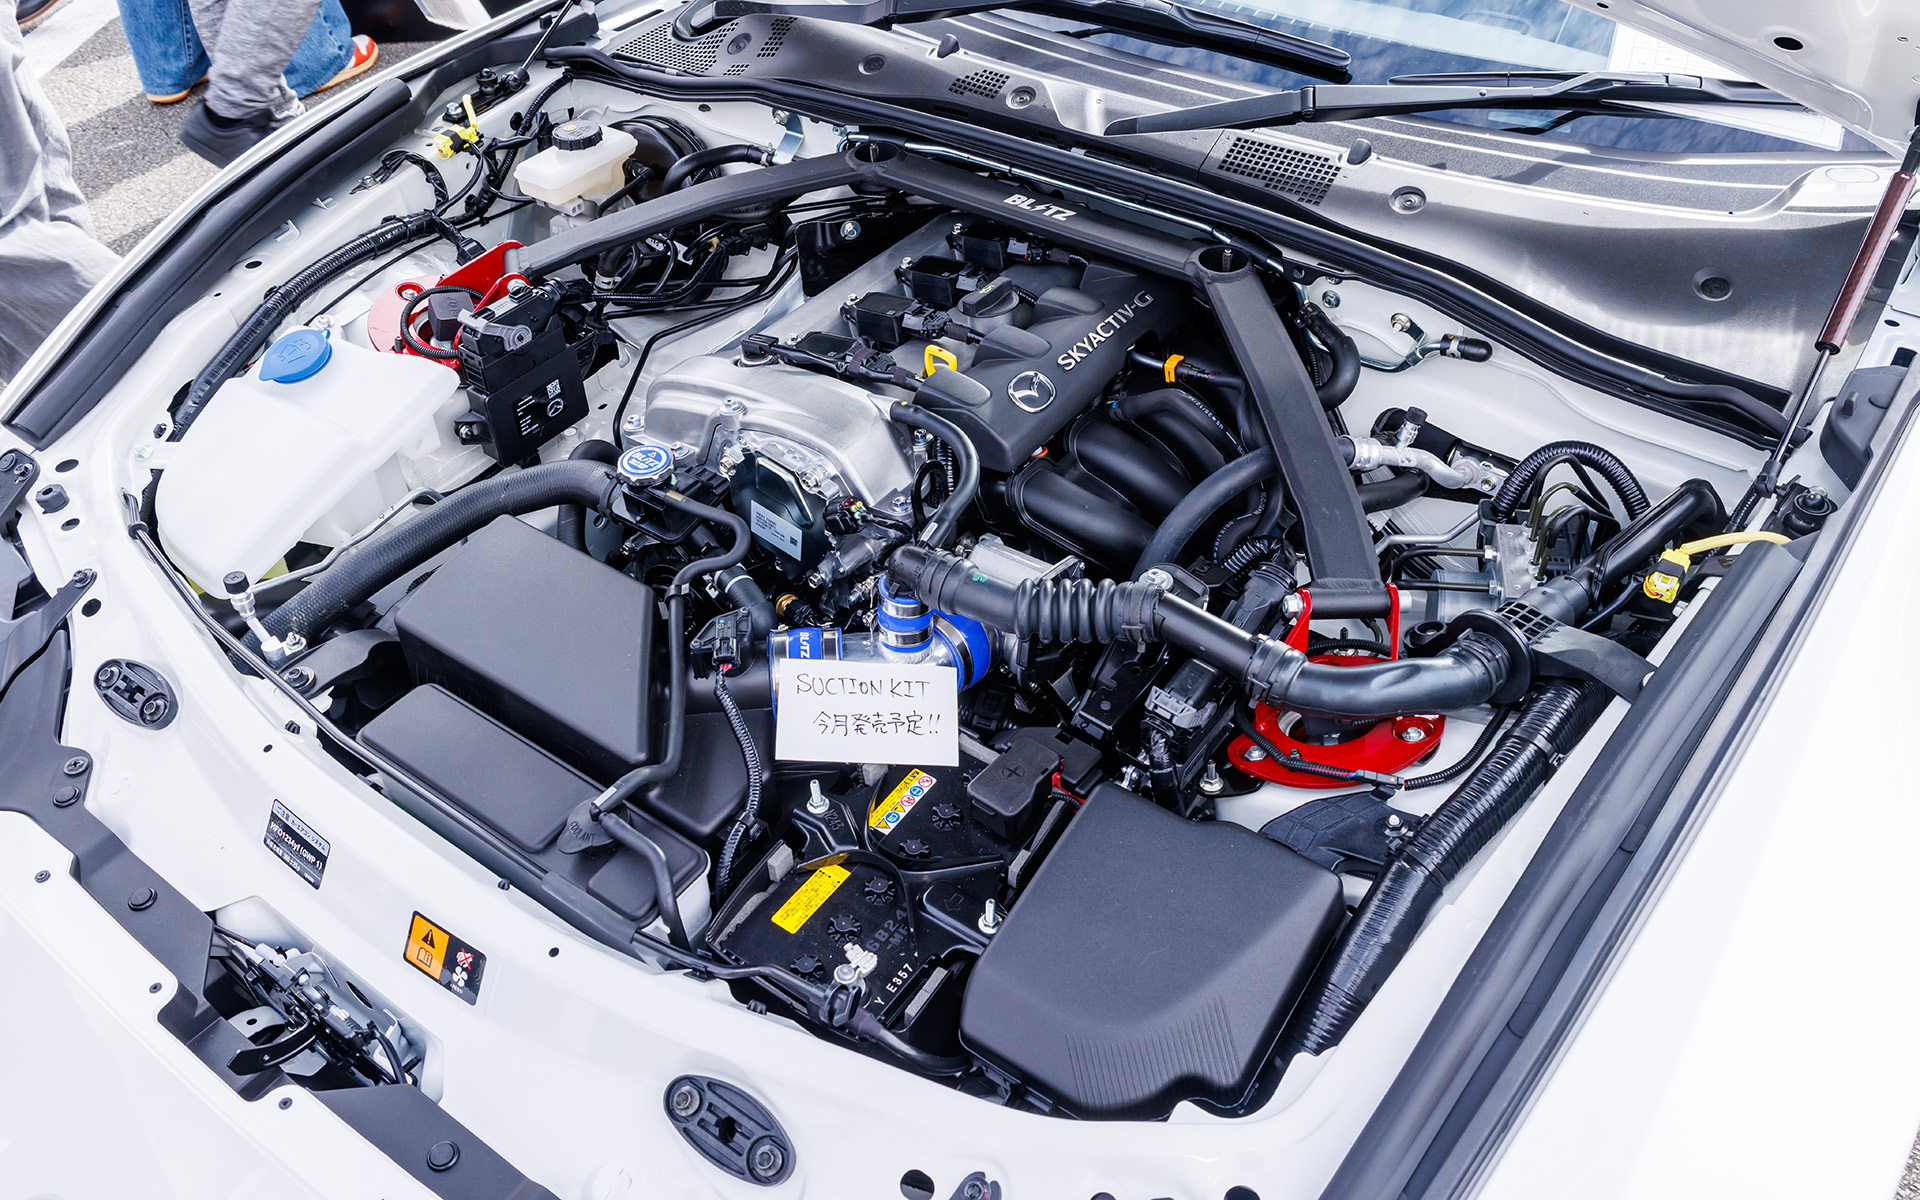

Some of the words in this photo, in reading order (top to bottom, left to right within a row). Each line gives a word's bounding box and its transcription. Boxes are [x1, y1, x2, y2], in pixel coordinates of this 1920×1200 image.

[1003, 193, 1077, 221] BLITZ
[1057, 290, 1154, 371] SKYACTIV-G
[799, 632, 811, 659] BLITZ
[796, 672, 883, 696] SUCTION
[890, 678, 931, 699] KIT
[812, 709, 942, 737] 今月発売予定!!
[570, 820, 596, 843] COOLANT
[885, 963, 914, 994] E357
